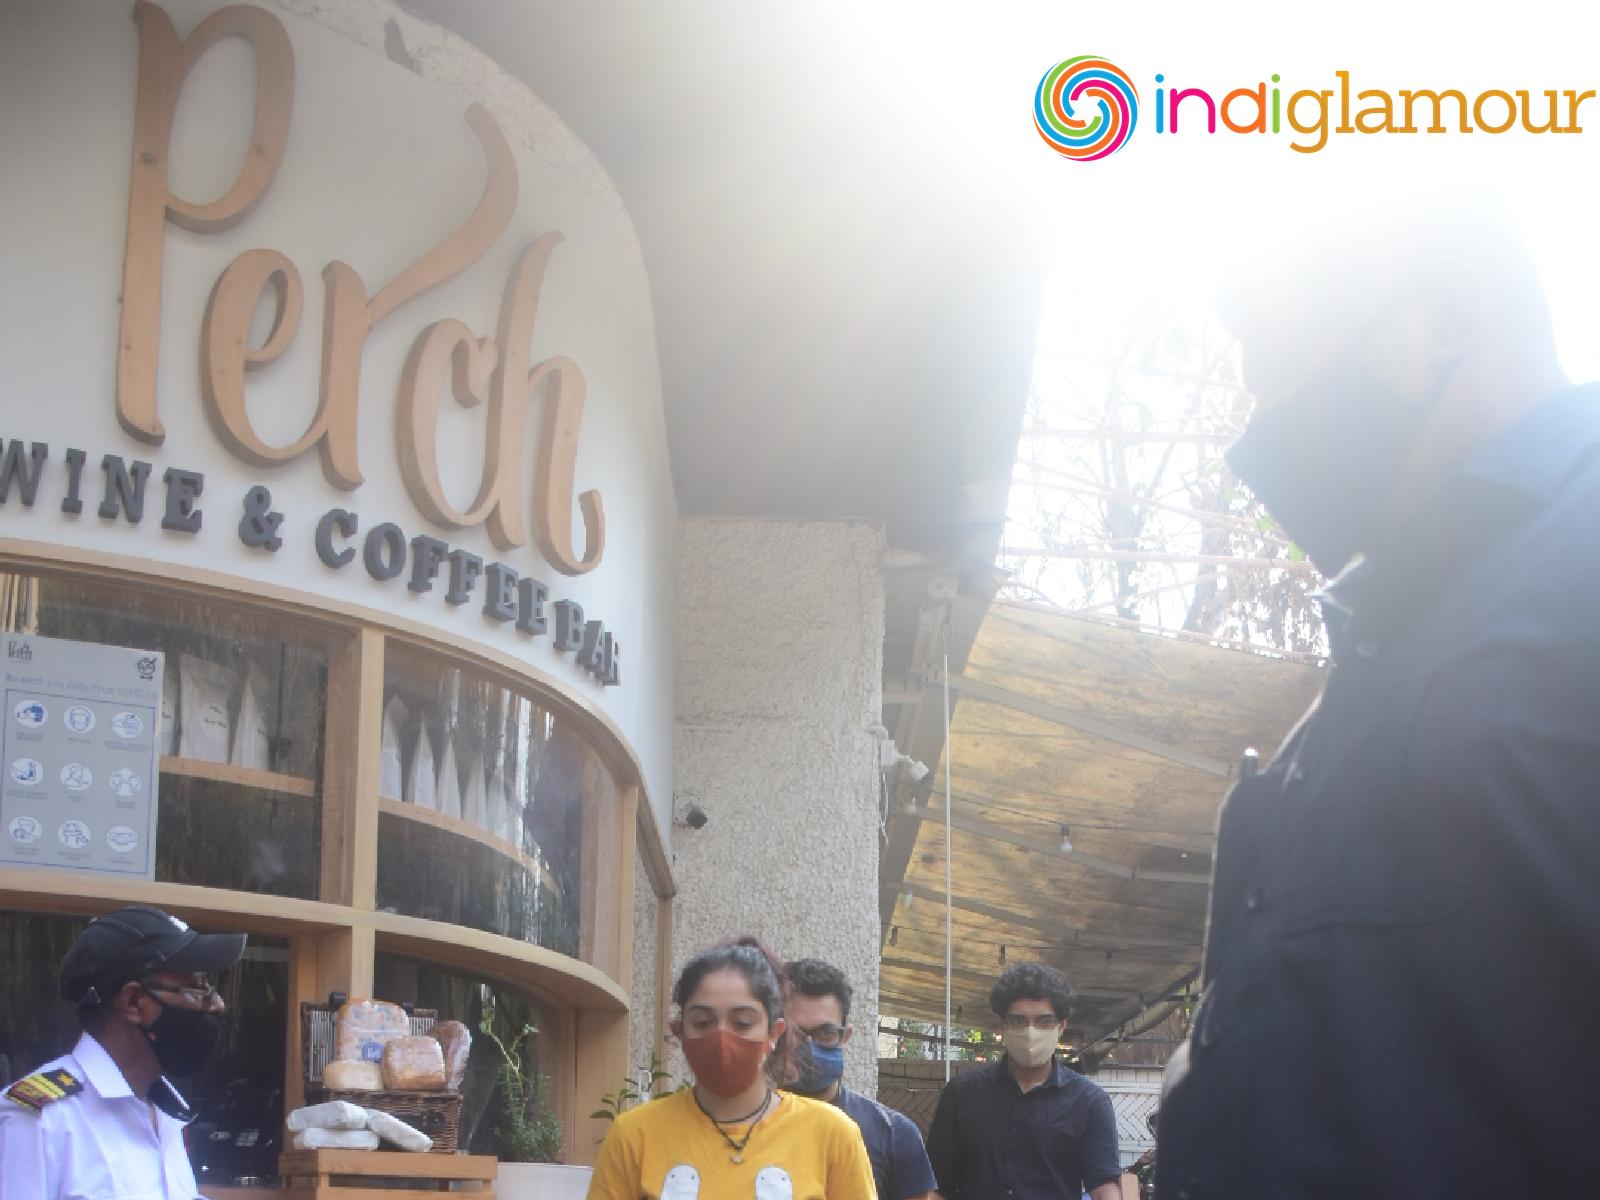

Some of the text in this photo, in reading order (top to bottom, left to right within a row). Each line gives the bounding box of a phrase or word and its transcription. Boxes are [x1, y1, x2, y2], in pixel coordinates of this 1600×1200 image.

[115, 0, 605, 577] Perch
[0, 437, 204, 534] WINE
[238, 484, 283, 552] &
[315, 507, 549, 636] COFFEE
